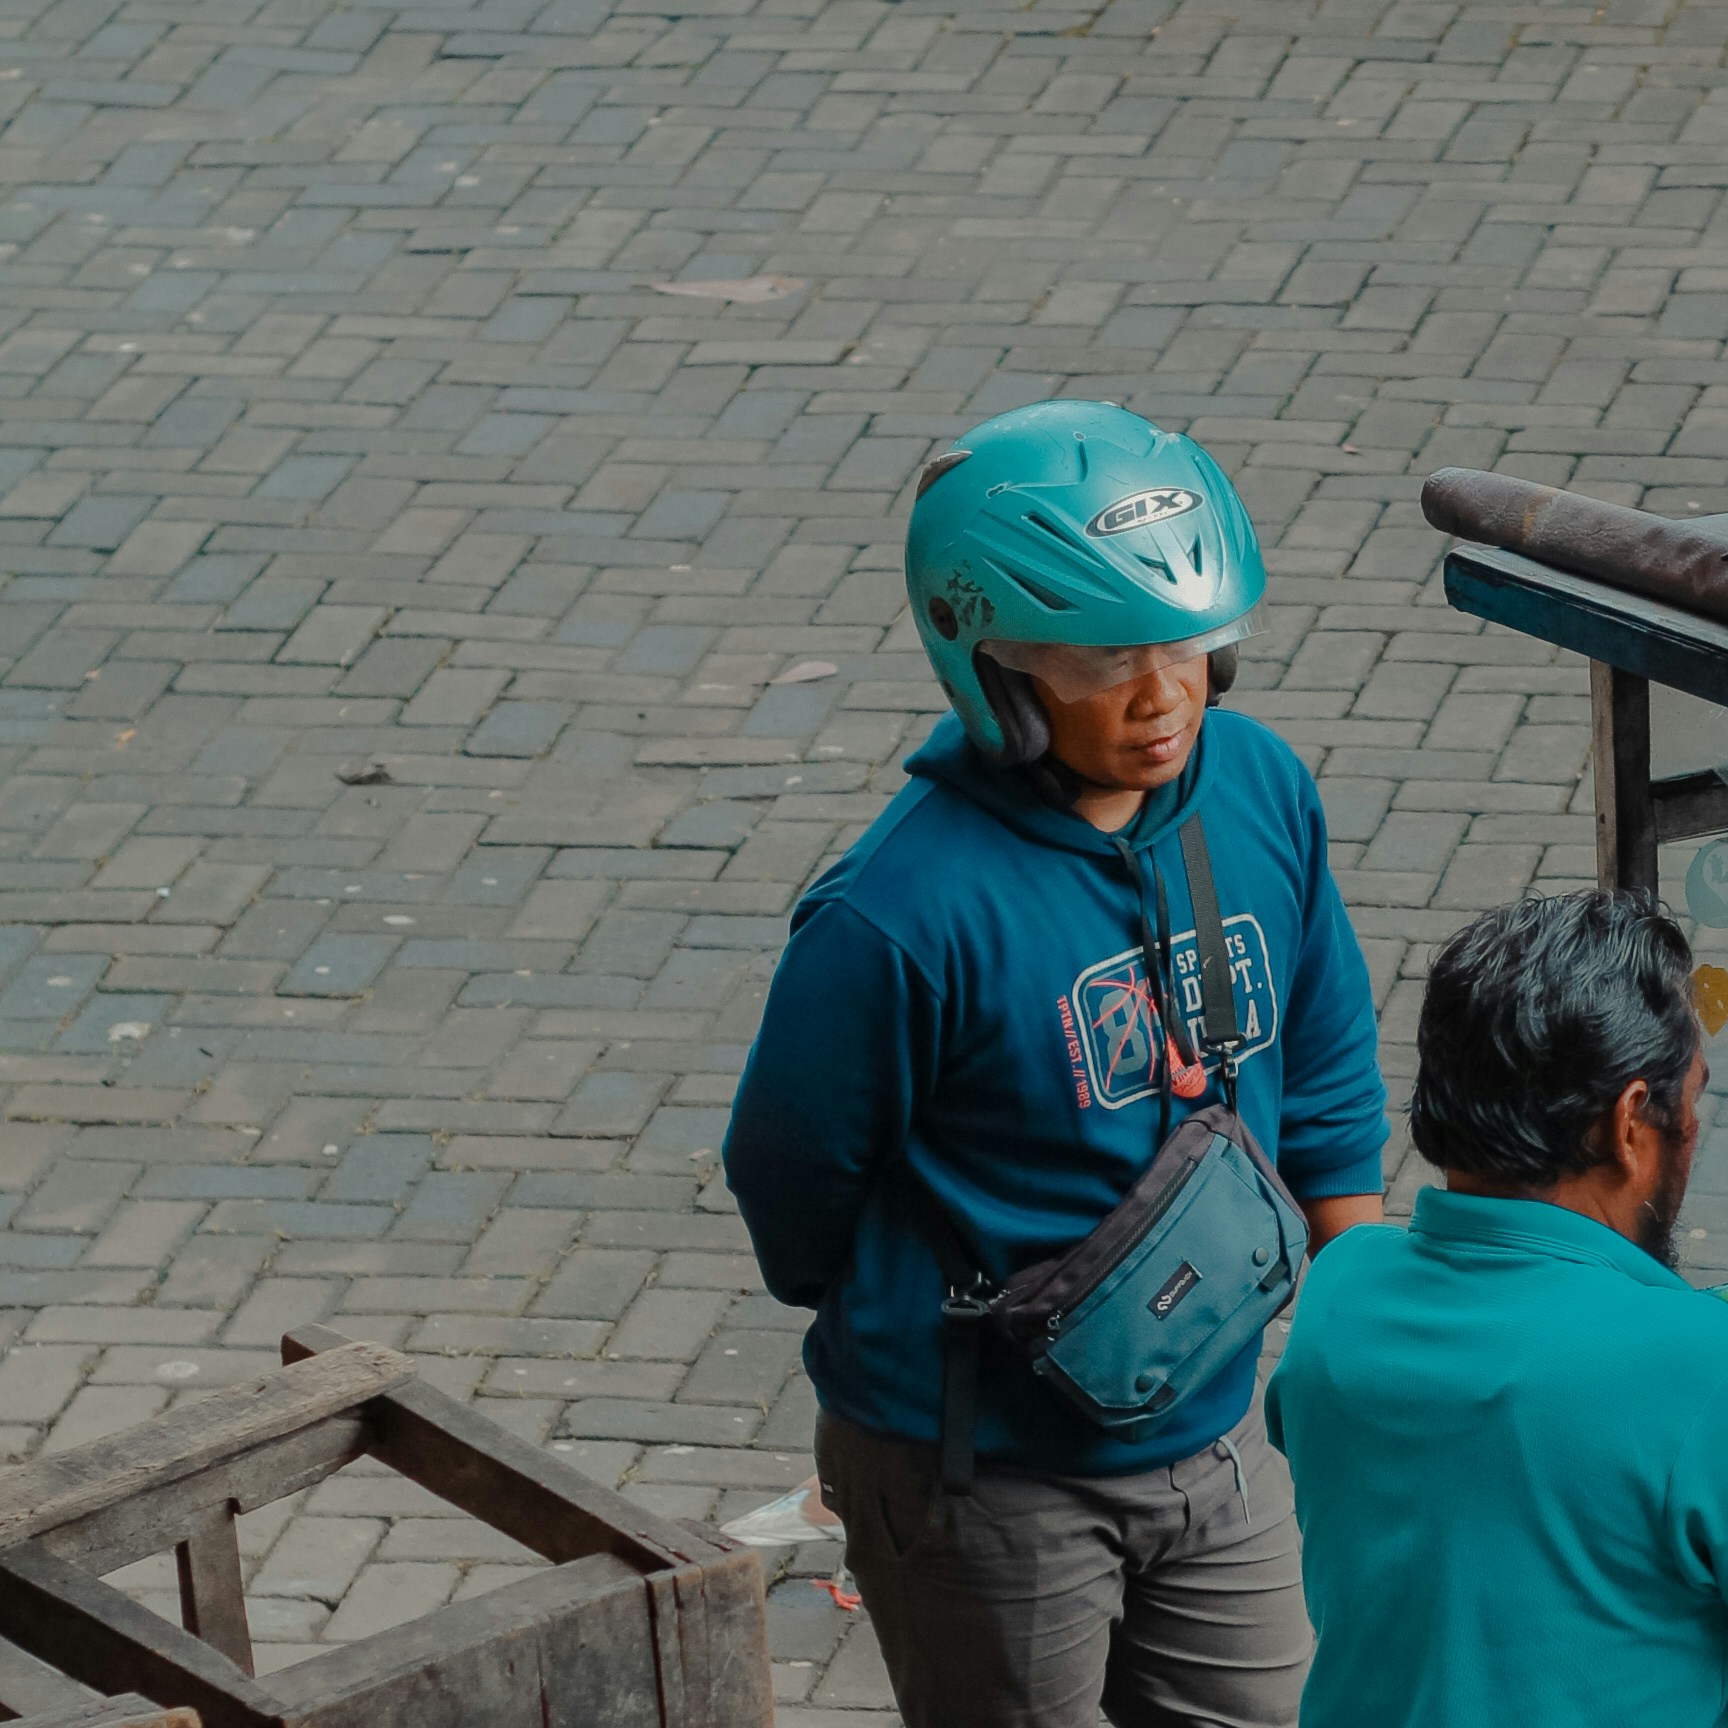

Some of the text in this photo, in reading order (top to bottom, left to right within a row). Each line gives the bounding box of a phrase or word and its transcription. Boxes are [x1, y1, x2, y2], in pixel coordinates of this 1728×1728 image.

[1103, 491, 1183, 530] GIX
[1176, 934, 1246, 974] SPTS
[1182, 958, 1263, 1013] DT.
